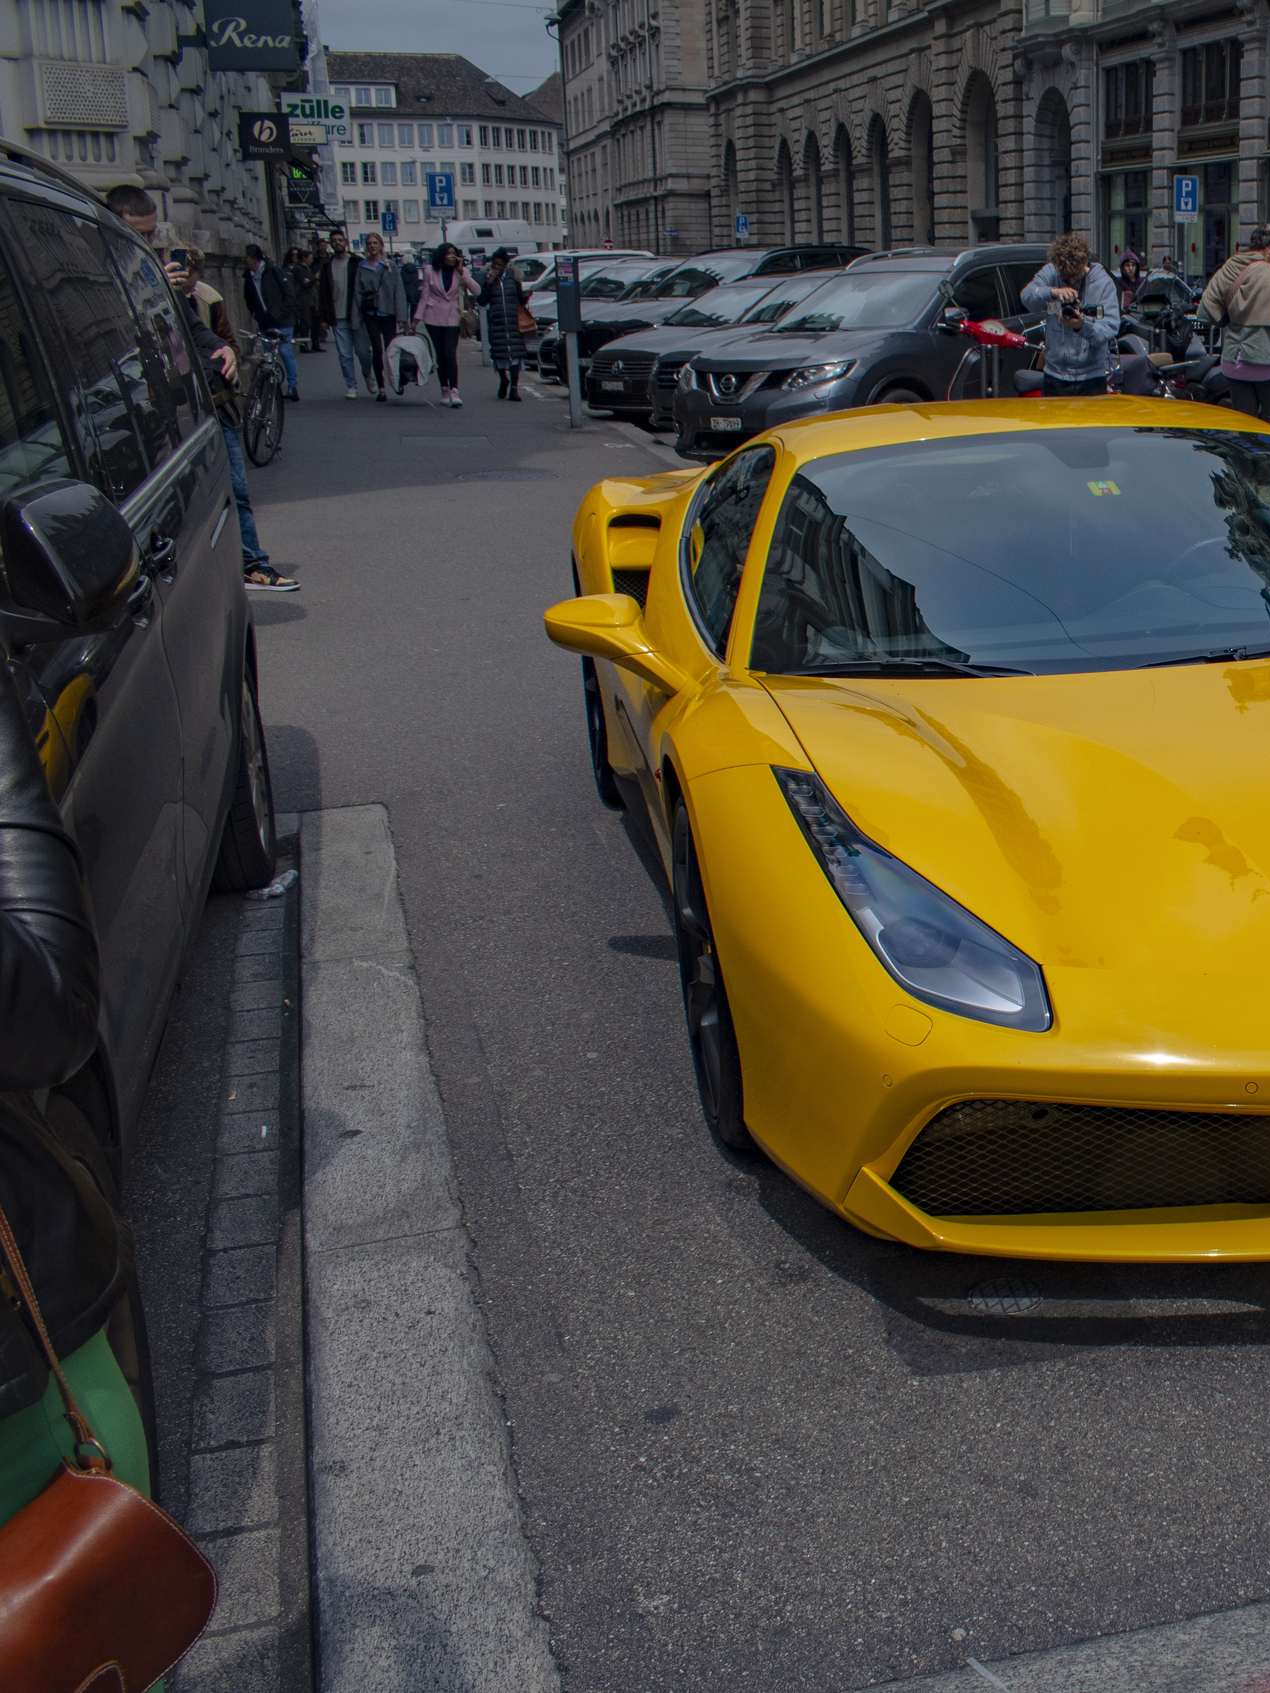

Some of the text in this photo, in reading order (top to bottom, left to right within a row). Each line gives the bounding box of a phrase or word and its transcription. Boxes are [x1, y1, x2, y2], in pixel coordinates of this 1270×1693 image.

[209, 17, 292, 48] Rena
[249, 145, 284, 154] Branders
[434, 175, 446, 192] P
[1182, 180, 1192, 197] P
[385, 213, 392, 223] P
